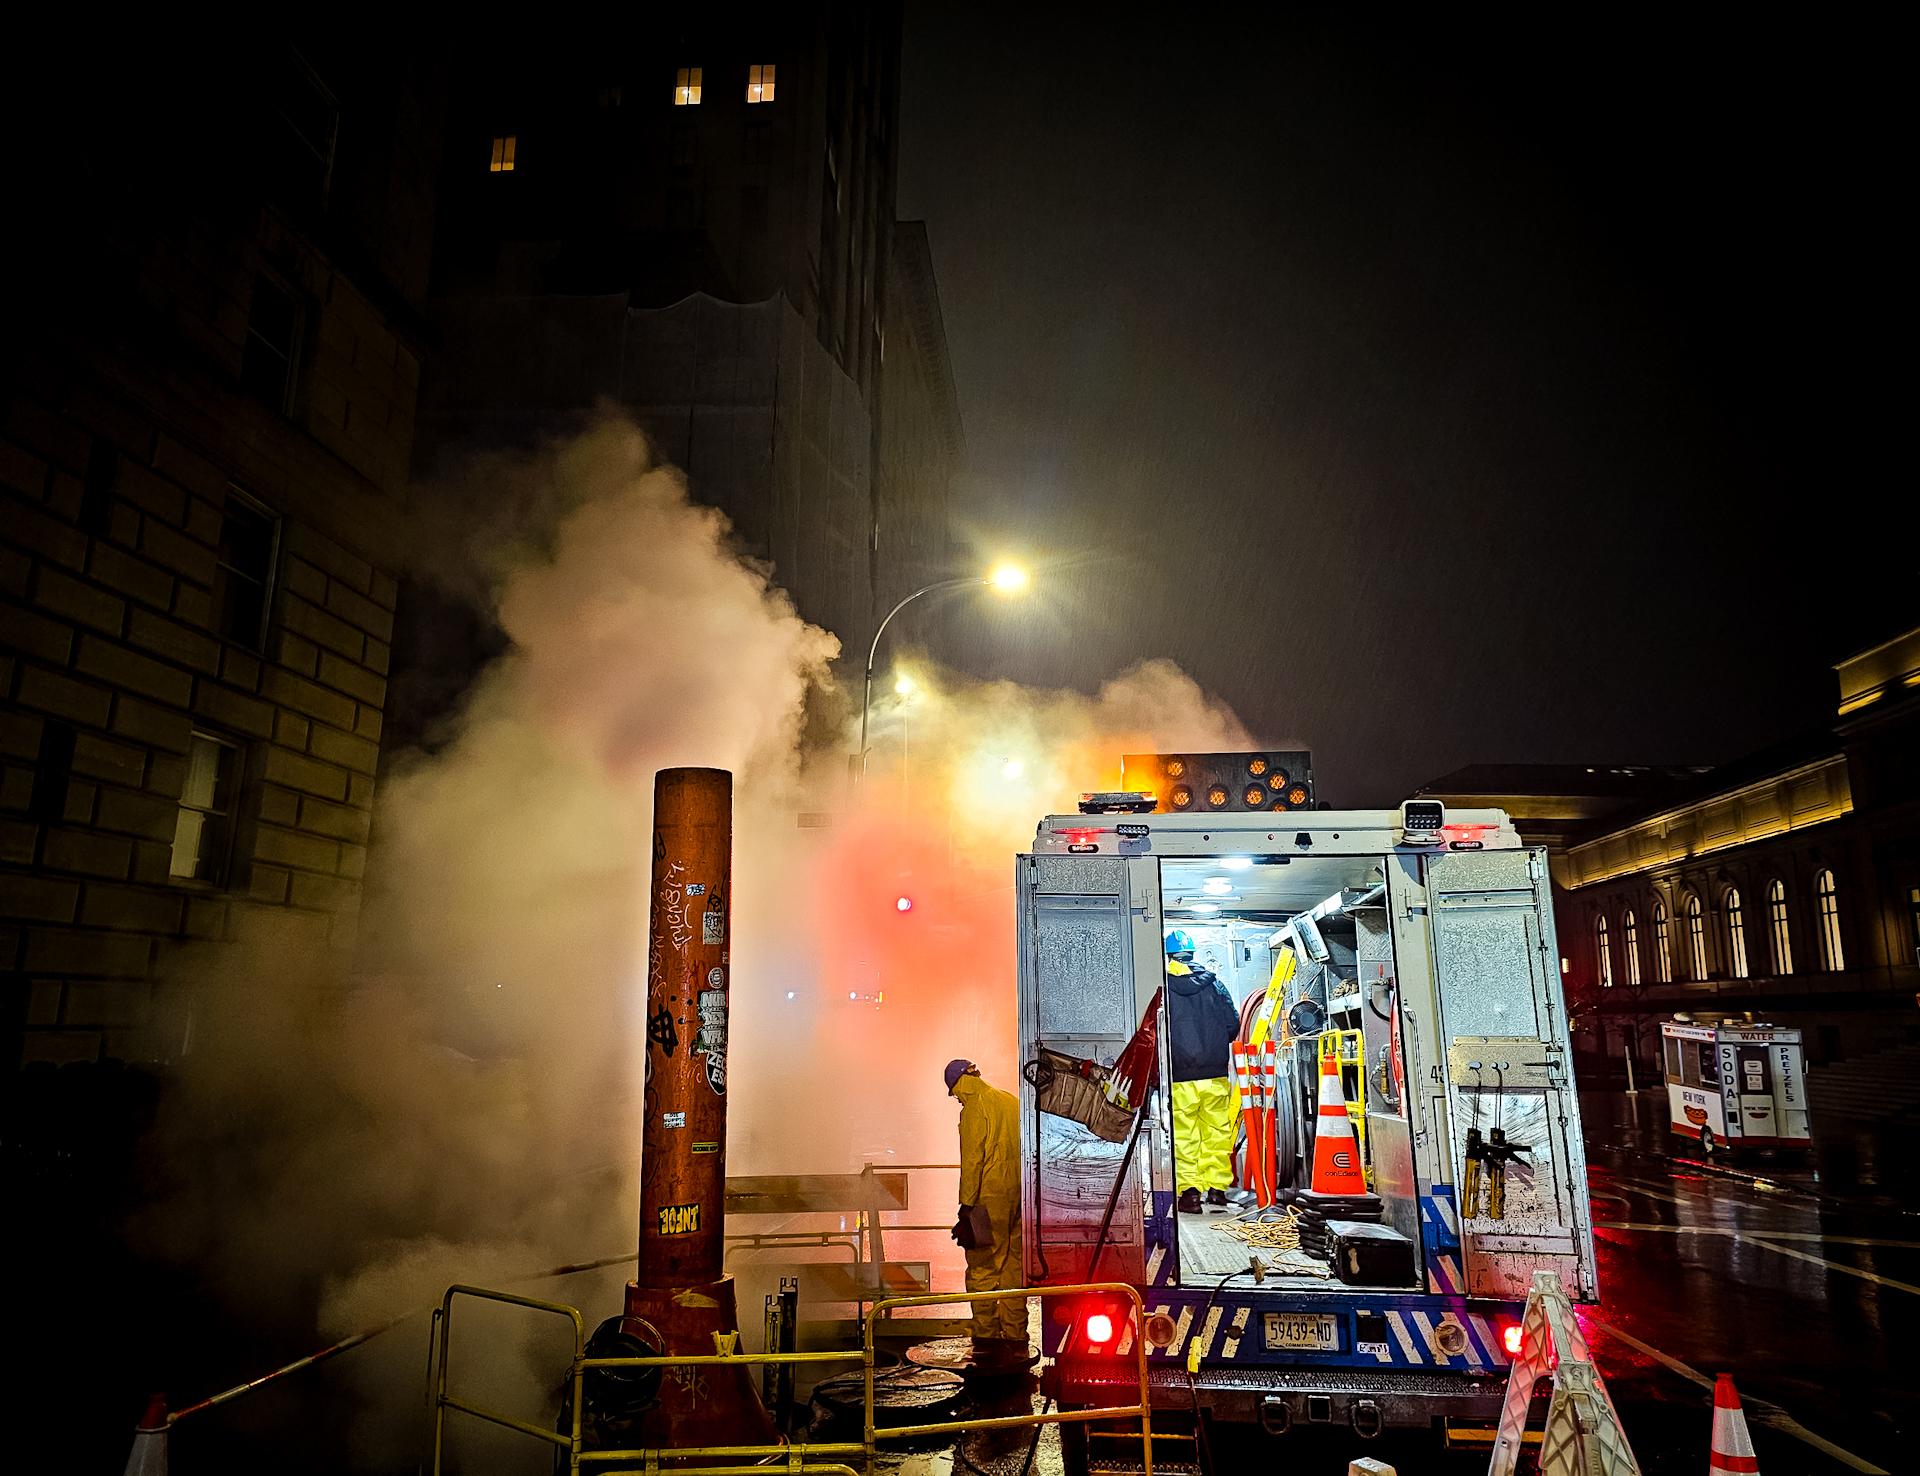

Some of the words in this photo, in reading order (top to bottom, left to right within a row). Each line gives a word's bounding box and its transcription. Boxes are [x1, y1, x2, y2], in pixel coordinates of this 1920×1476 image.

[1740, 1032, 1775, 1041] WATER
[1722, 1048, 1736, 1099] SODA
[1780, 1047, 1794, 1103] PRETZELS
[1683, 1091, 1692, 1102] NEW
[1693, 1094, 1706, 1106] YORK
